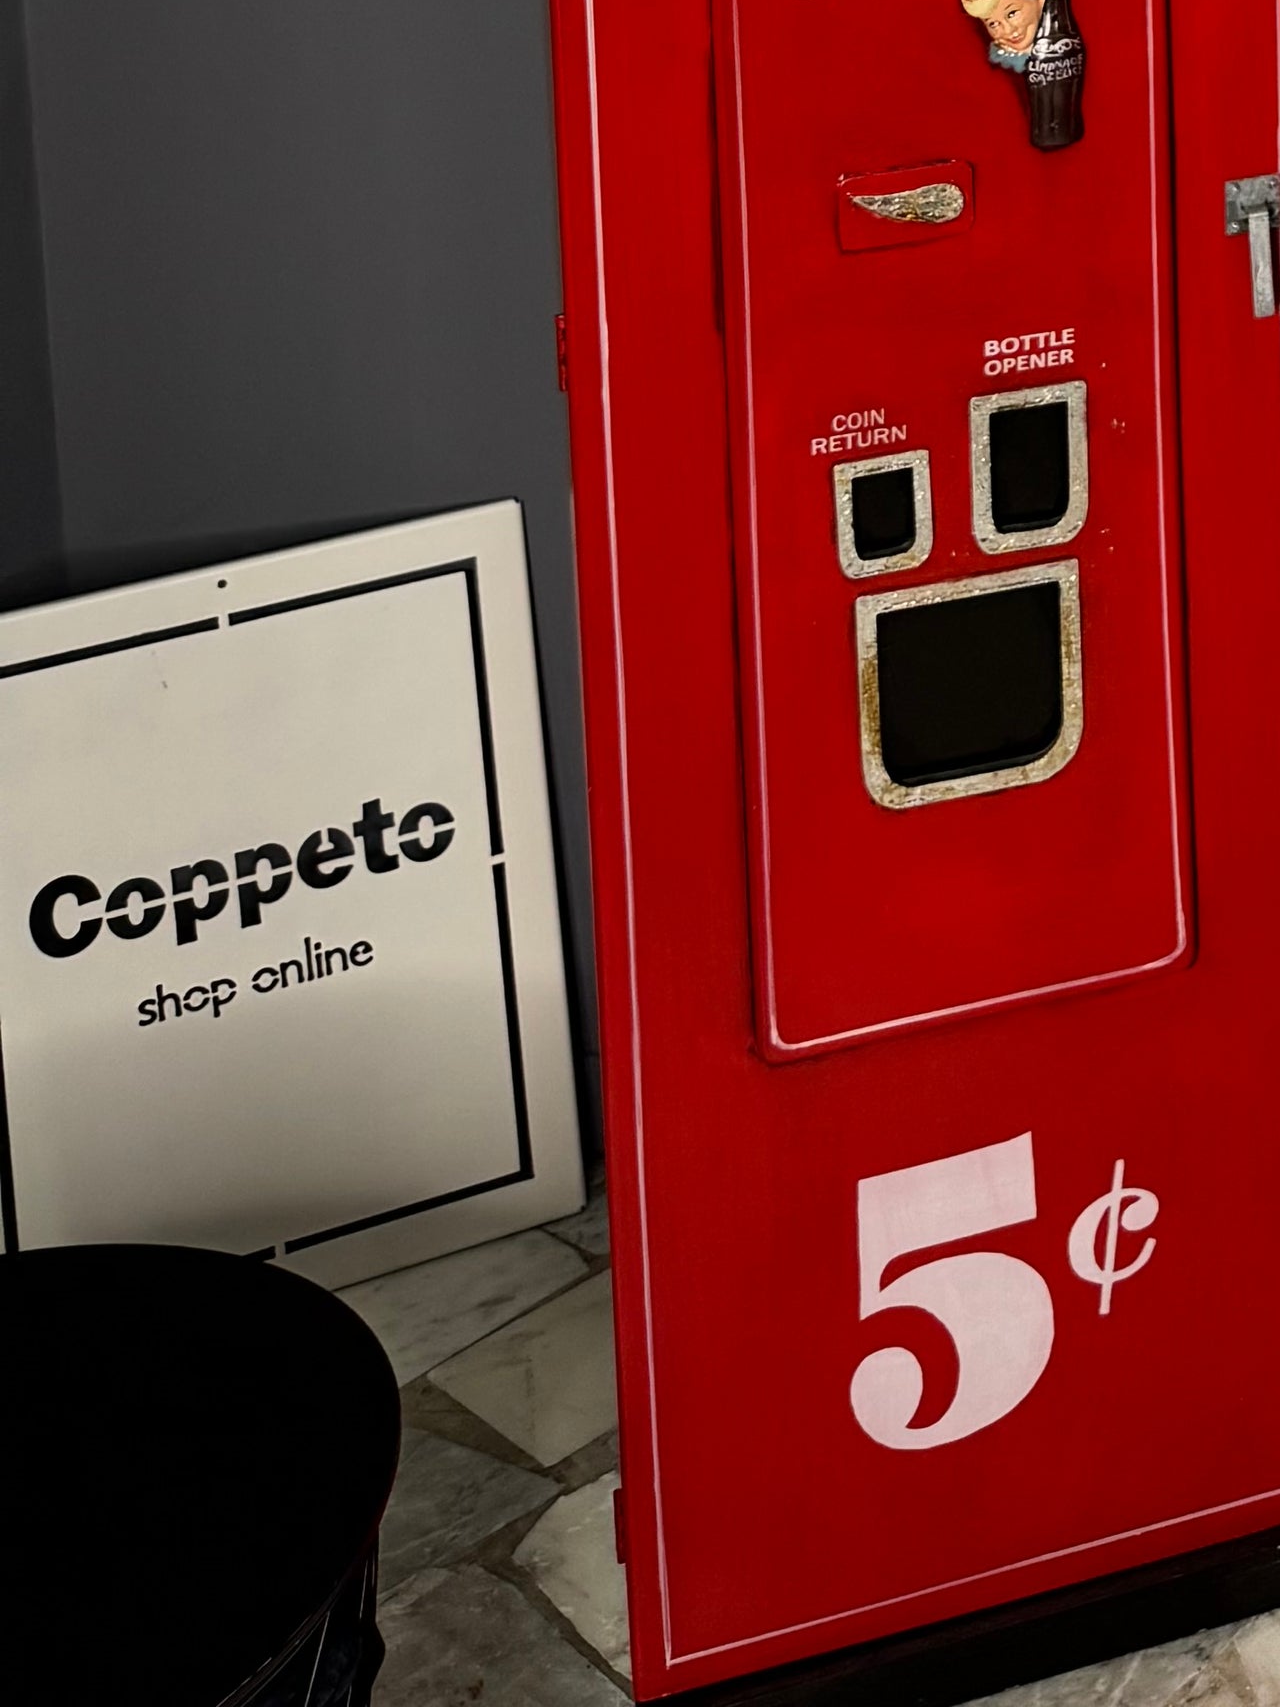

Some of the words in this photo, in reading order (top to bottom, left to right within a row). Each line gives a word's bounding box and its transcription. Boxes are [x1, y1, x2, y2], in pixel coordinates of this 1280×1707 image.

[983, 328, 1075, 357] BOTTLE
[984, 349, 1074, 377] OPENER
[832, 408, 885, 432] COIN
[810, 425, 907, 456] RETURN
[29, 798, 456, 959] Coppeto
[138, 976, 237, 1027] shop
[251, 936, 374, 996] online
